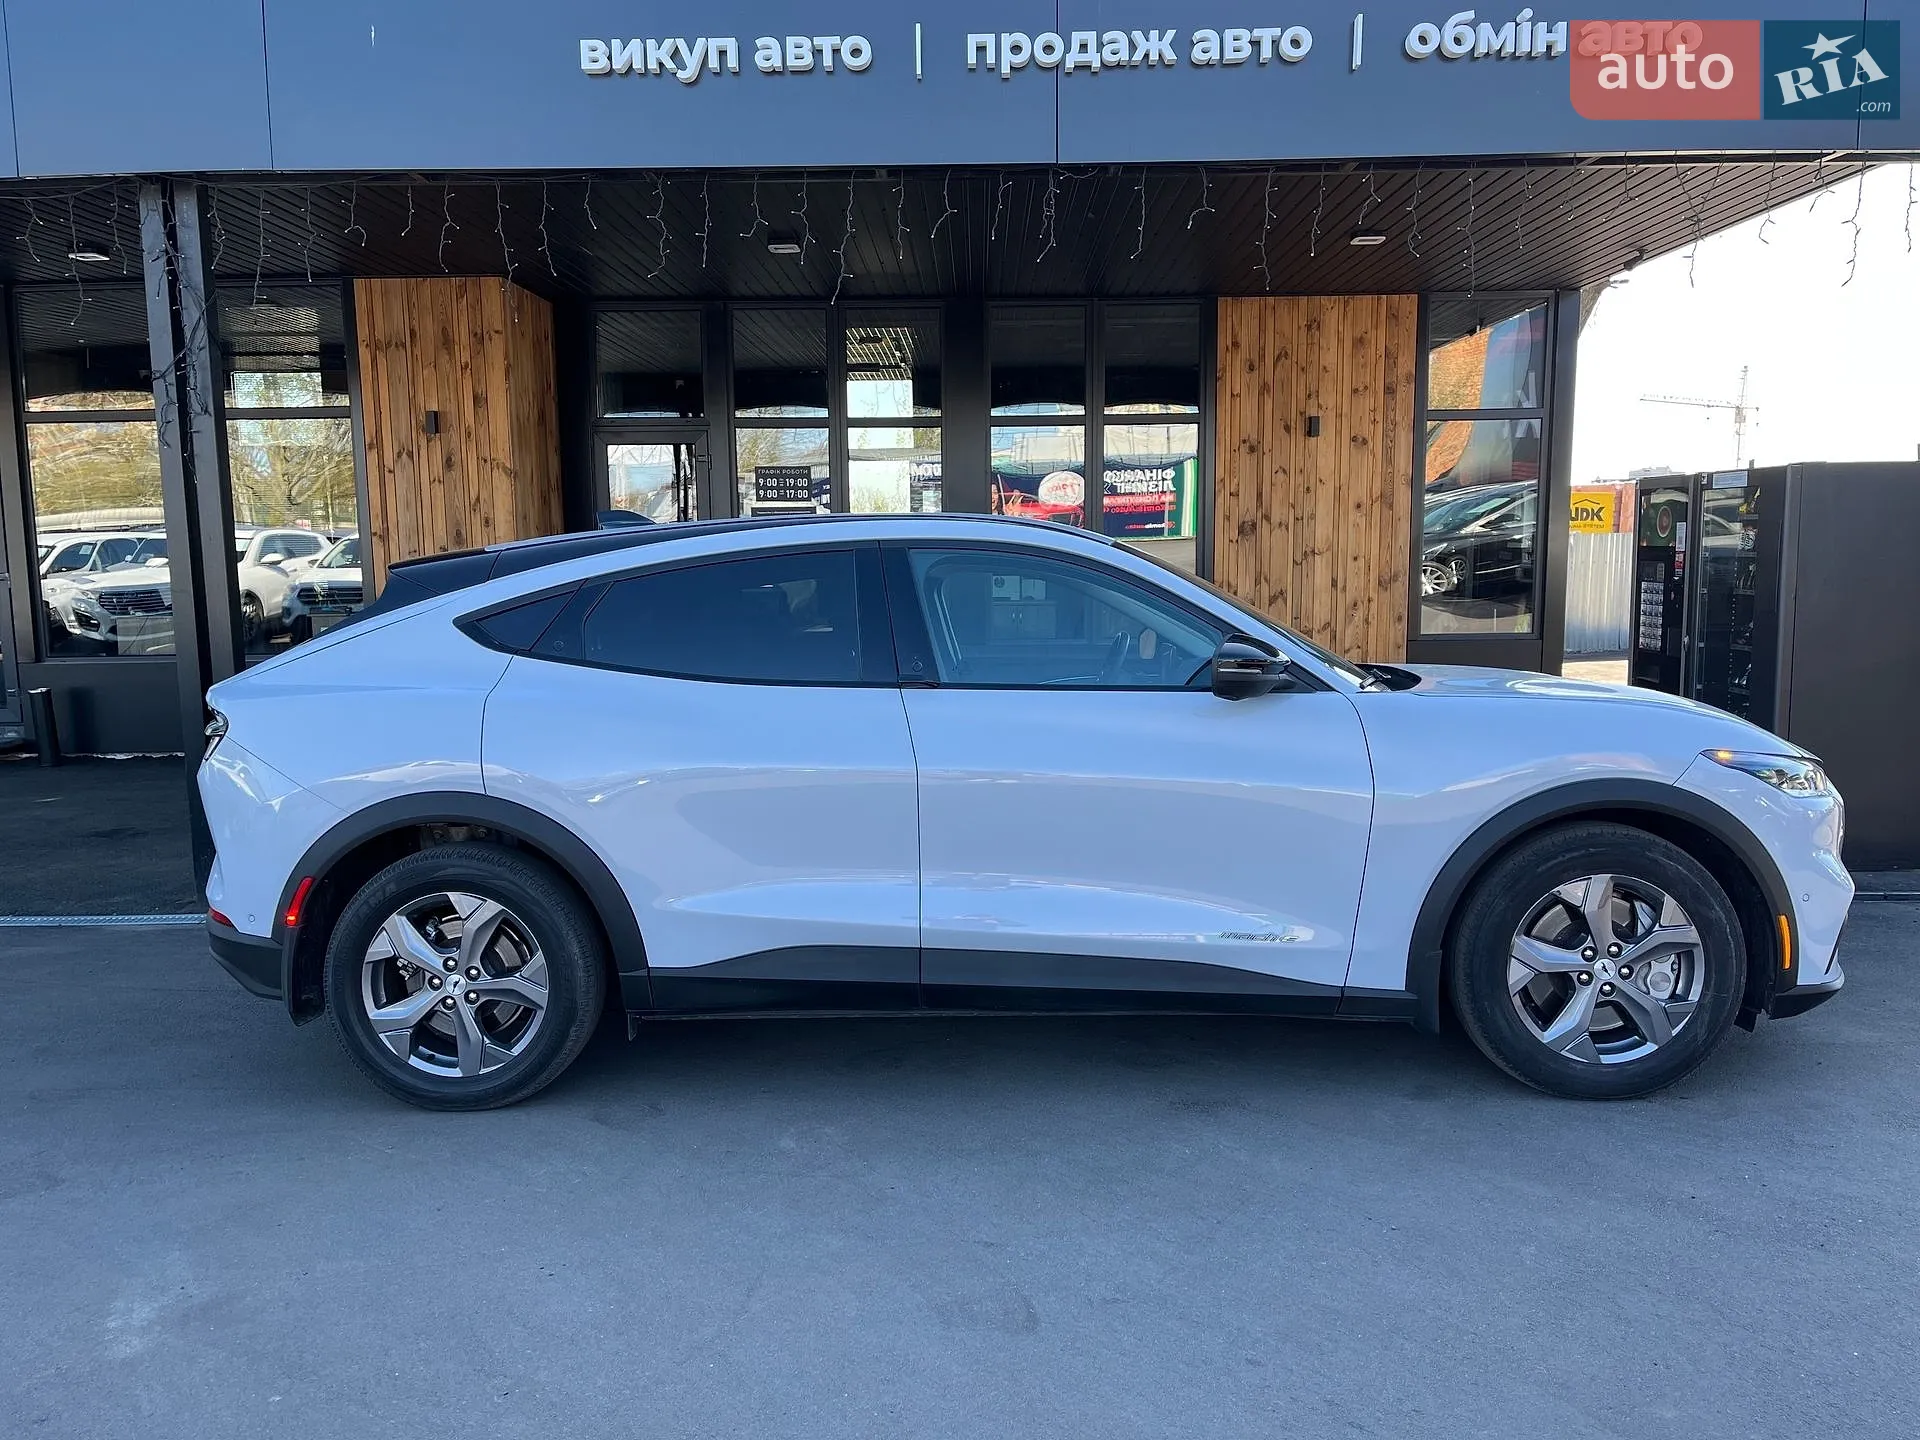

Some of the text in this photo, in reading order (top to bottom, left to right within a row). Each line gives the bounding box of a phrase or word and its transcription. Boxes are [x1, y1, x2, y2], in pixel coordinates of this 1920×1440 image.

[579, 8, 1703, 84] викуп авто продаж авто обмін авто
[758, 478, 778, 487] 9:00
[786, 478, 808, 487] 19:00
[758, 489, 778, 498] 9:00
[786, 489, 808, 498] 17:00
